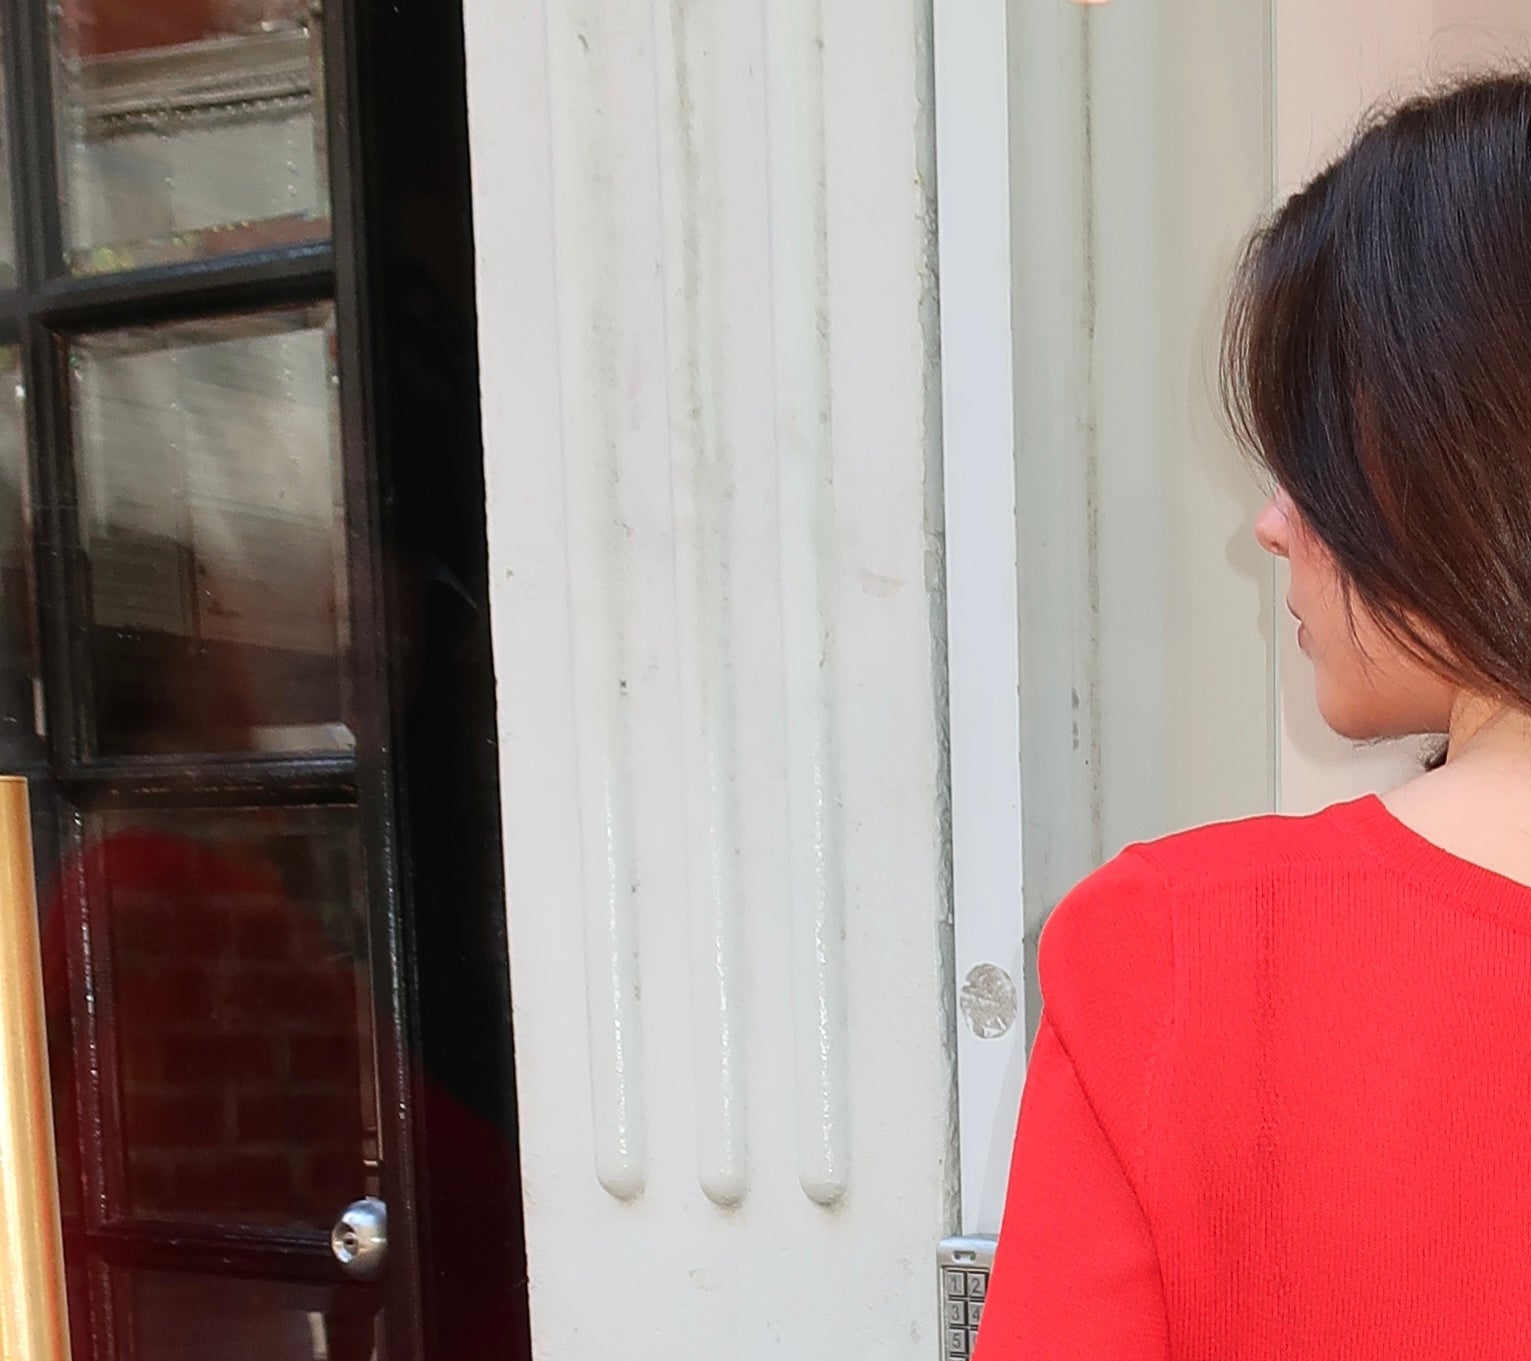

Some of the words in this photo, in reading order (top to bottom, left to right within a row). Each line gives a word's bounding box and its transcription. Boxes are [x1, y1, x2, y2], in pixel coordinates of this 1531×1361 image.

[950, 1275, 962, 1294] 1
[971, 1277, 981, 1294] 2
[951, 1304, 960, 1321] 3
[971, 1304, 981, 1321] 4
[952, 1332, 961, 1349] 5
